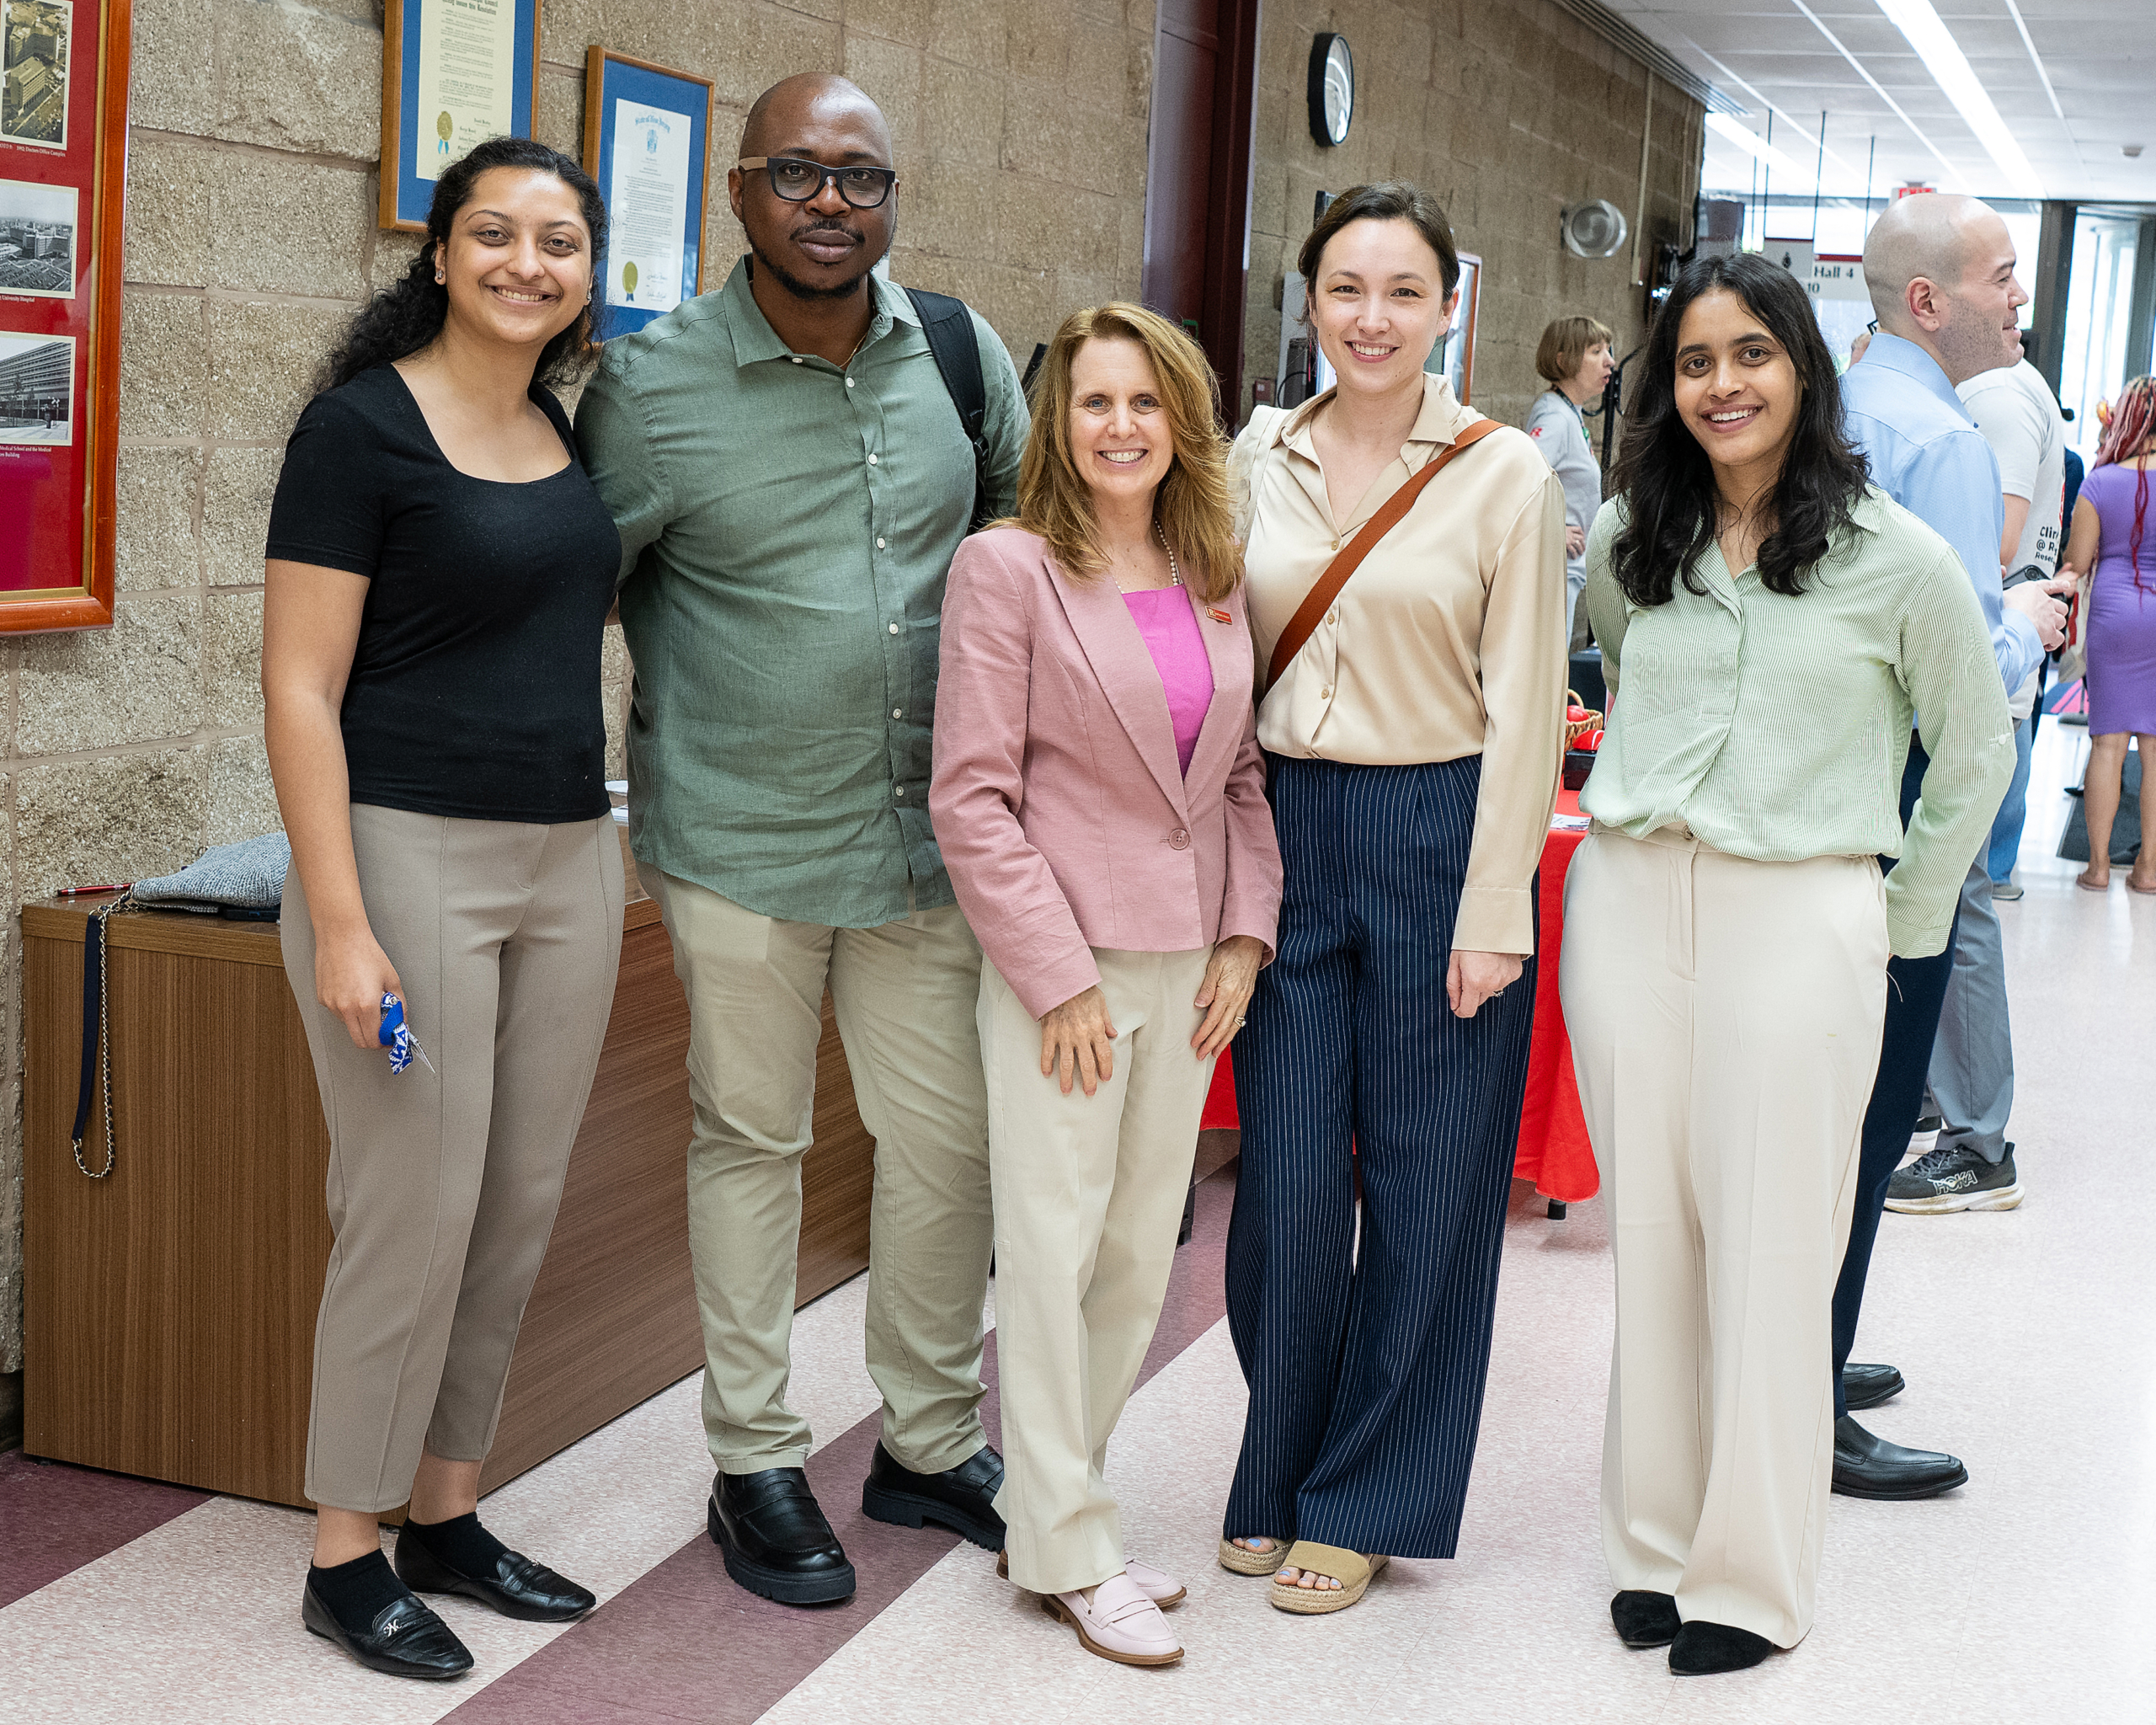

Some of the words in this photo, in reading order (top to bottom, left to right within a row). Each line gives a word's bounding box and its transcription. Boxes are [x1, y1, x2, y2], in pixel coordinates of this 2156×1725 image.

[1813, 265, 1841, 279] Hall
[1846, 266, 1854, 279] 4
[2036, 538, 2046, 551] @
[1933, 1169, 1978, 1196] HOKA
